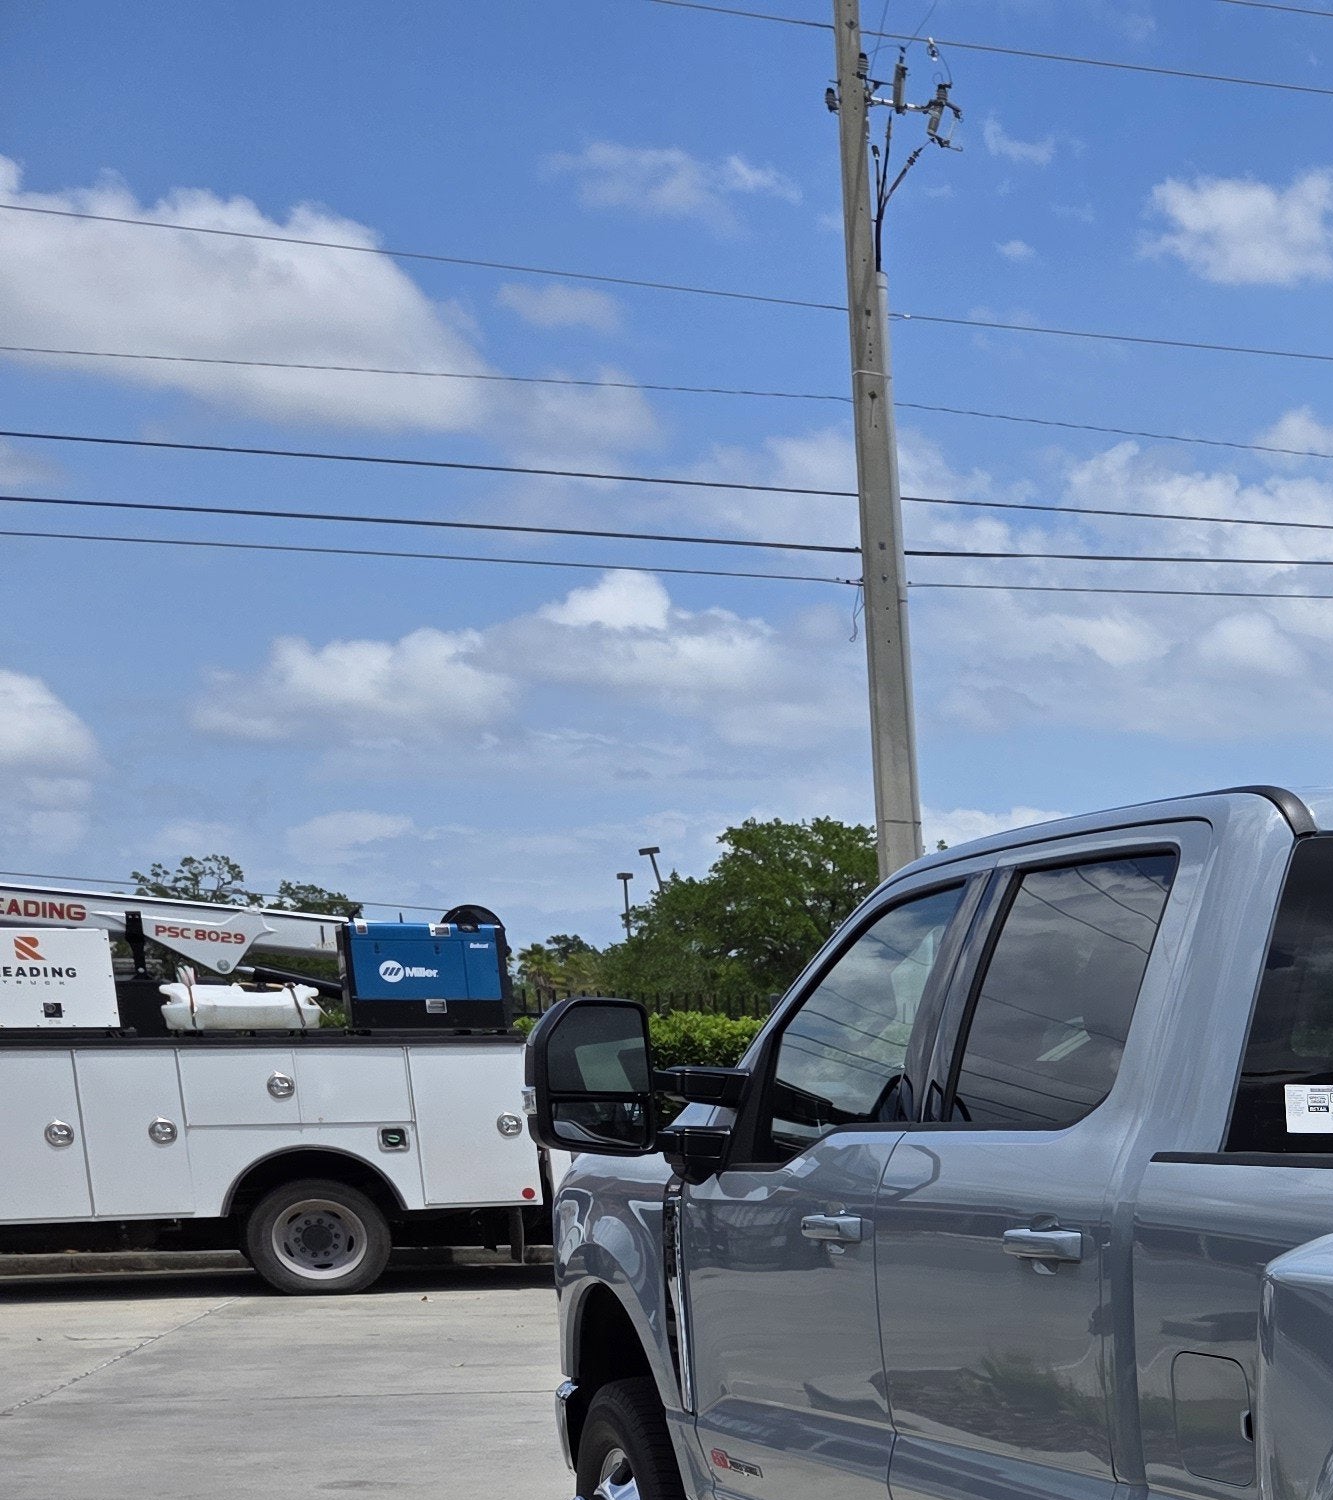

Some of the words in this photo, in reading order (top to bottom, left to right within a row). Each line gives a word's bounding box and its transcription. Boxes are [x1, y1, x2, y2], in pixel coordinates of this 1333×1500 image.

[155, 925, 191, 940] PSC
[194, 929, 246, 944] 8029
[0, 966, 77, 978] EADING
